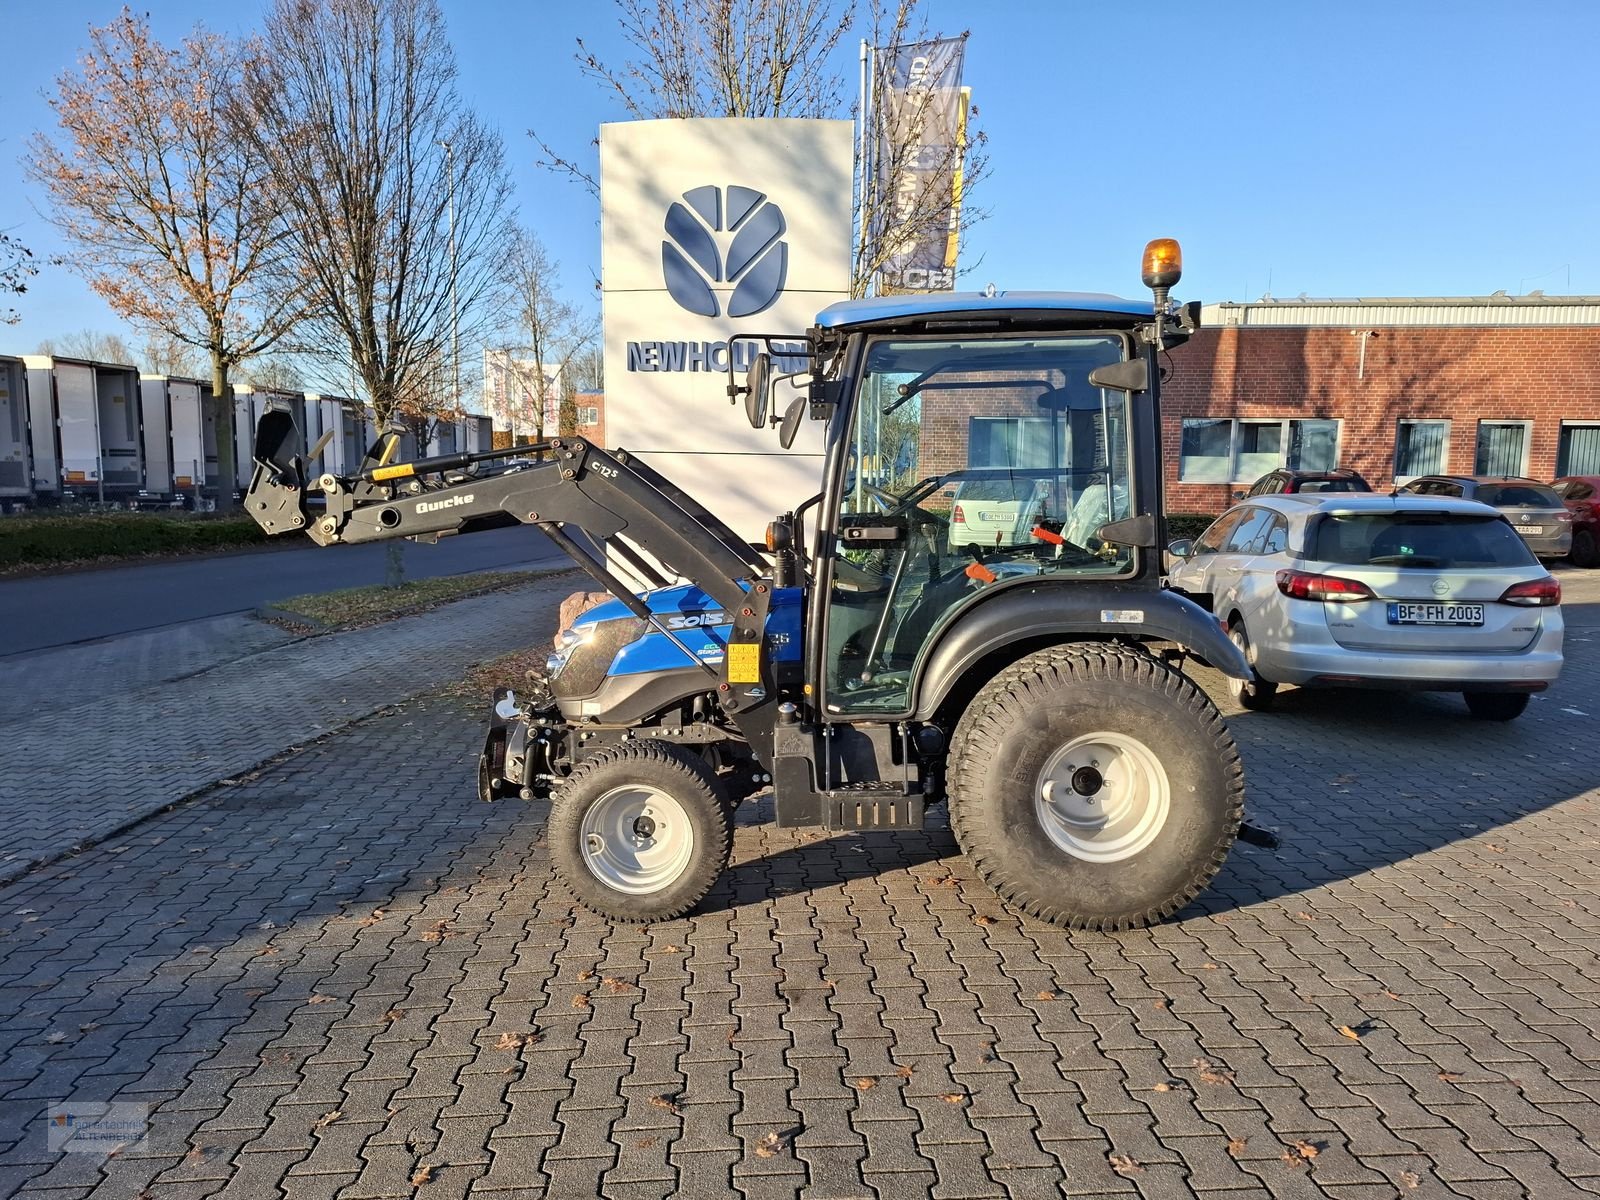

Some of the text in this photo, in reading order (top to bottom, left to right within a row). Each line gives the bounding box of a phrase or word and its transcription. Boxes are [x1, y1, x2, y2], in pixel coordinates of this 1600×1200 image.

[415, 494, 475, 514] Quicke
[1399, 605, 1482, 621] BF FH 2003
